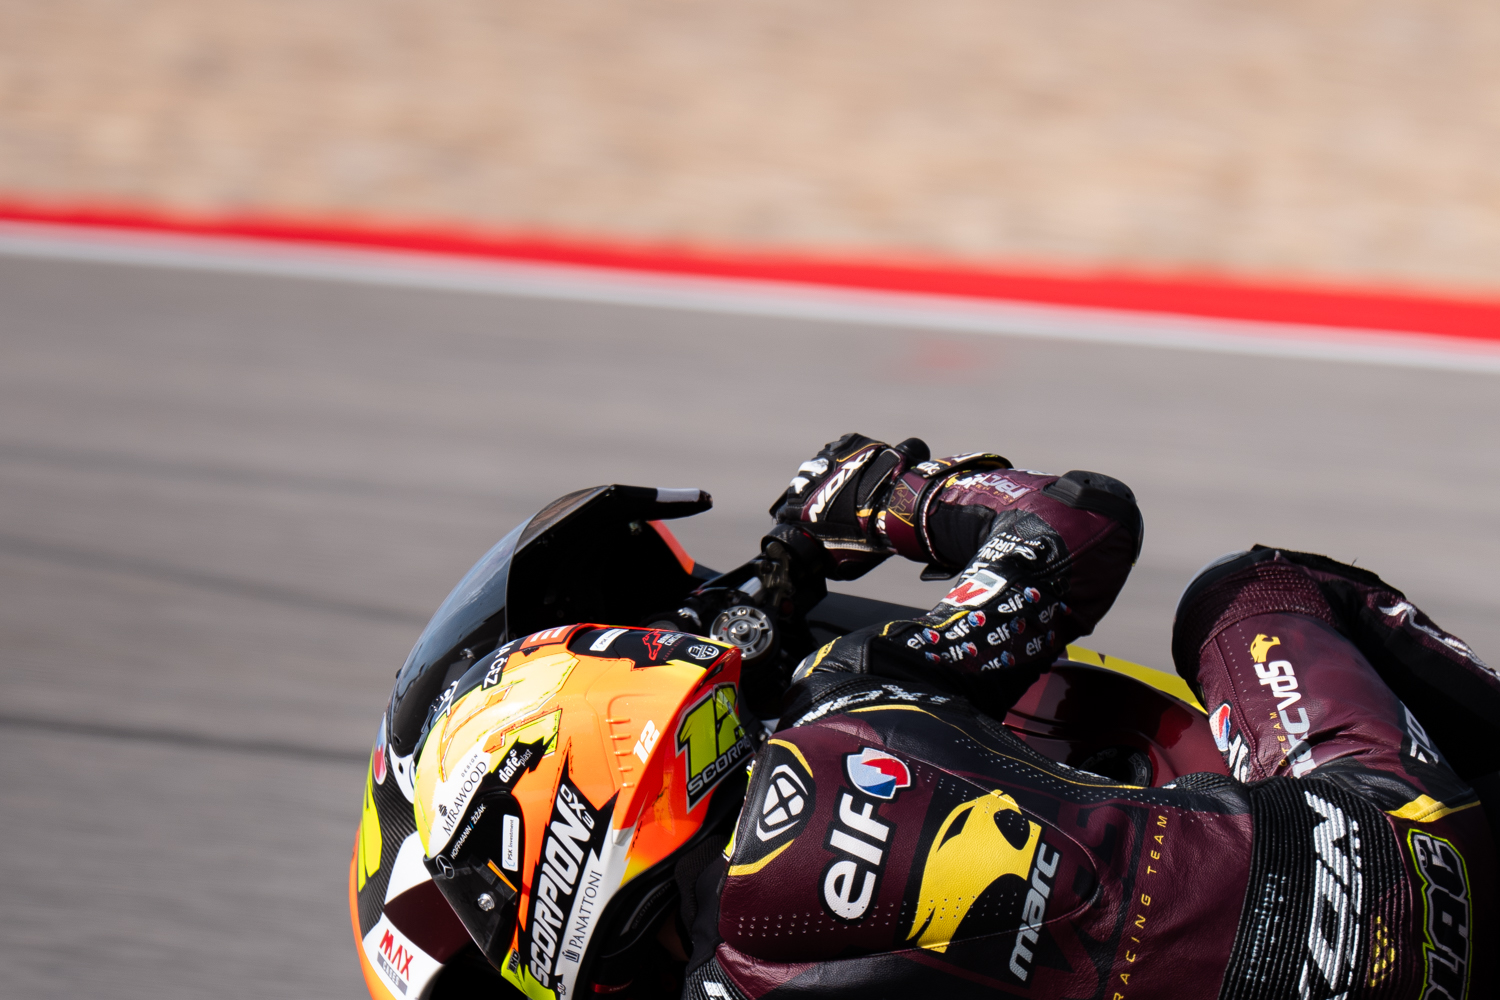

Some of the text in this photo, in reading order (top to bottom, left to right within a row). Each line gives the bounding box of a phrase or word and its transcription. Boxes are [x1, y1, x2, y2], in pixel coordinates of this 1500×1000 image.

[945, 618, 970, 640] elf
[997, 593, 1025, 614] elf
[1038, 602, 1060, 624] elf
[907, 632, 927, 650] el
[987, 622, 1011, 646] elf
[1025, 634, 1046, 657] elf
[1253, 659, 1302, 711] vds
[633, 719, 660, 765] 12
[442, 761, 487, 837] MIRAWOOD
[823, 792, 888, 920] elf
[1146, 814, 1168, 875] TEAM
[530, 798, 591, 988] SCORPION
[569, 870, 603, 950] PANATTONI
[1009, 842, 1060, 982] marc
[379, 928, 414, 981] MAX
